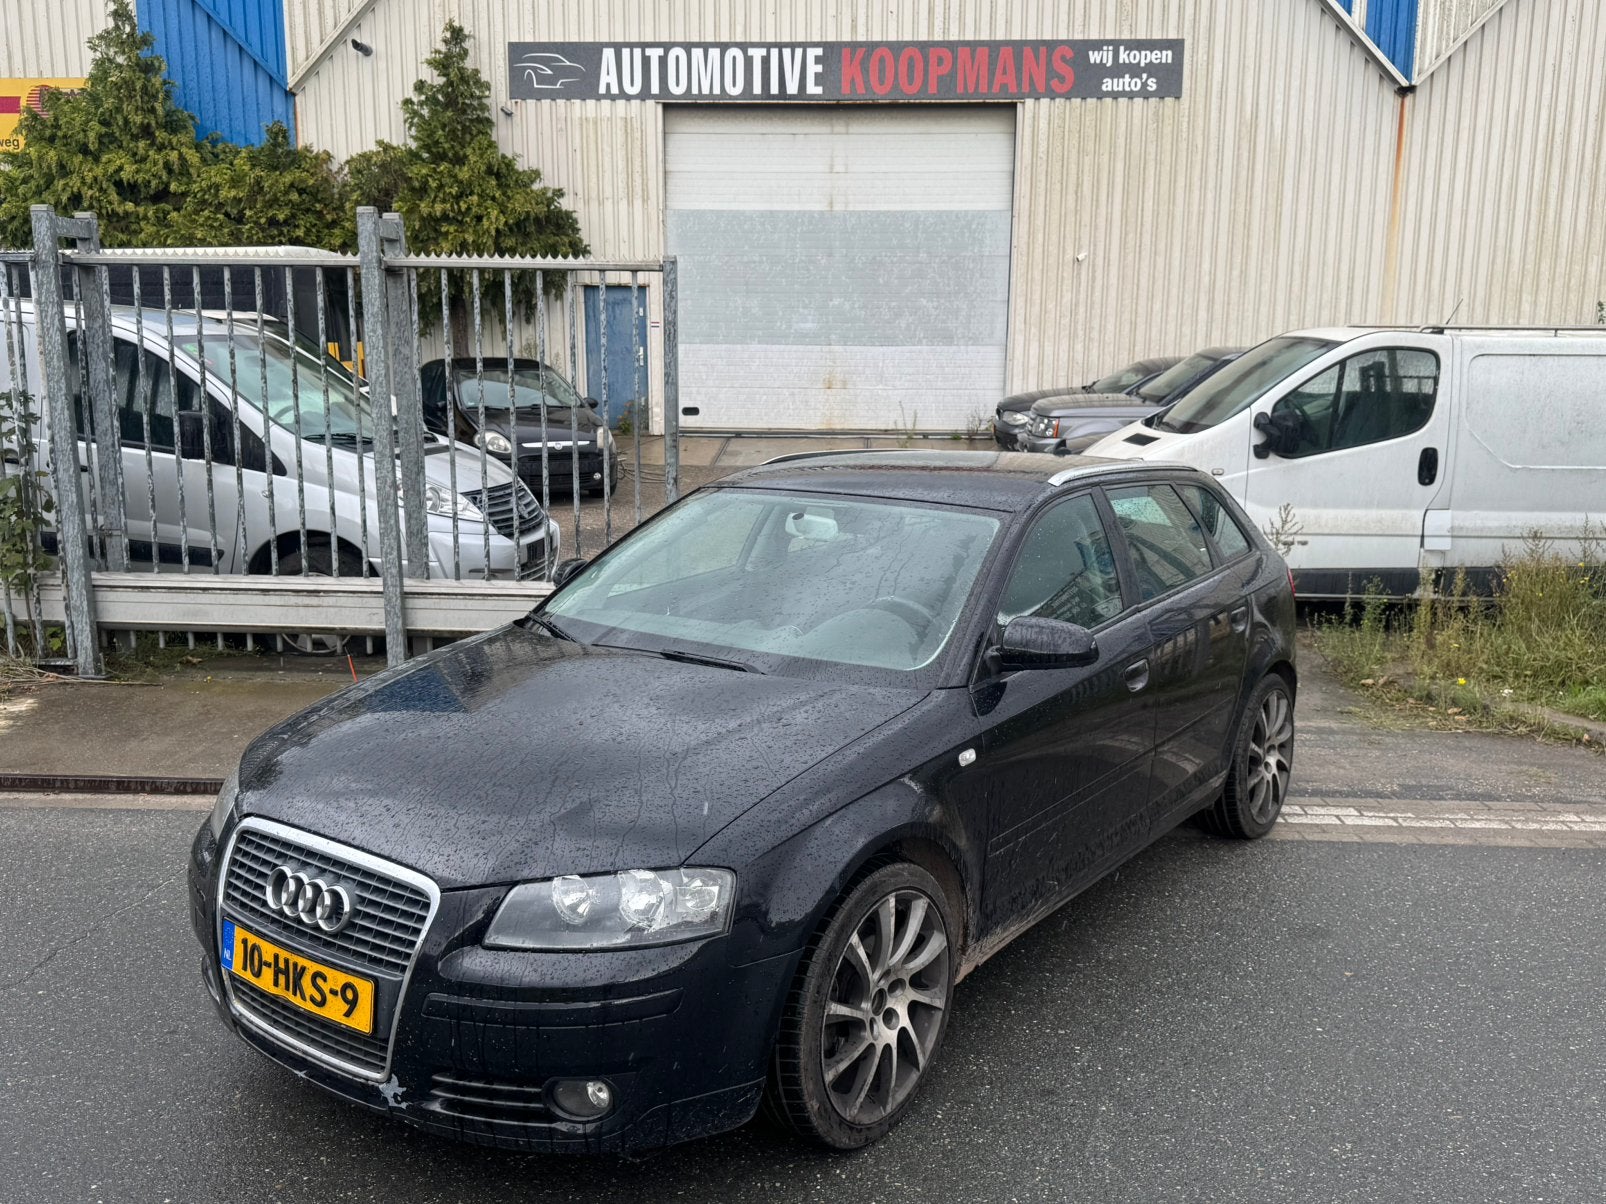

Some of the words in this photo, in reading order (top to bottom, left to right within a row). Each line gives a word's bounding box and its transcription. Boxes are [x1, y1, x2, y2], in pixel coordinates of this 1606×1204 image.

[1088, 45, 1114, 67] wij
[1118, 45, 1173, 67] kopen
[598, 46, 824, 96] AUTOMOTIVE
[841, 45, 1075, 96] KOOPMANS
[1101, 73, 1158, 92] auto's
[223, 947, 232, 961] NL
[241, 937, 359, 1018] 10-HKS-9
